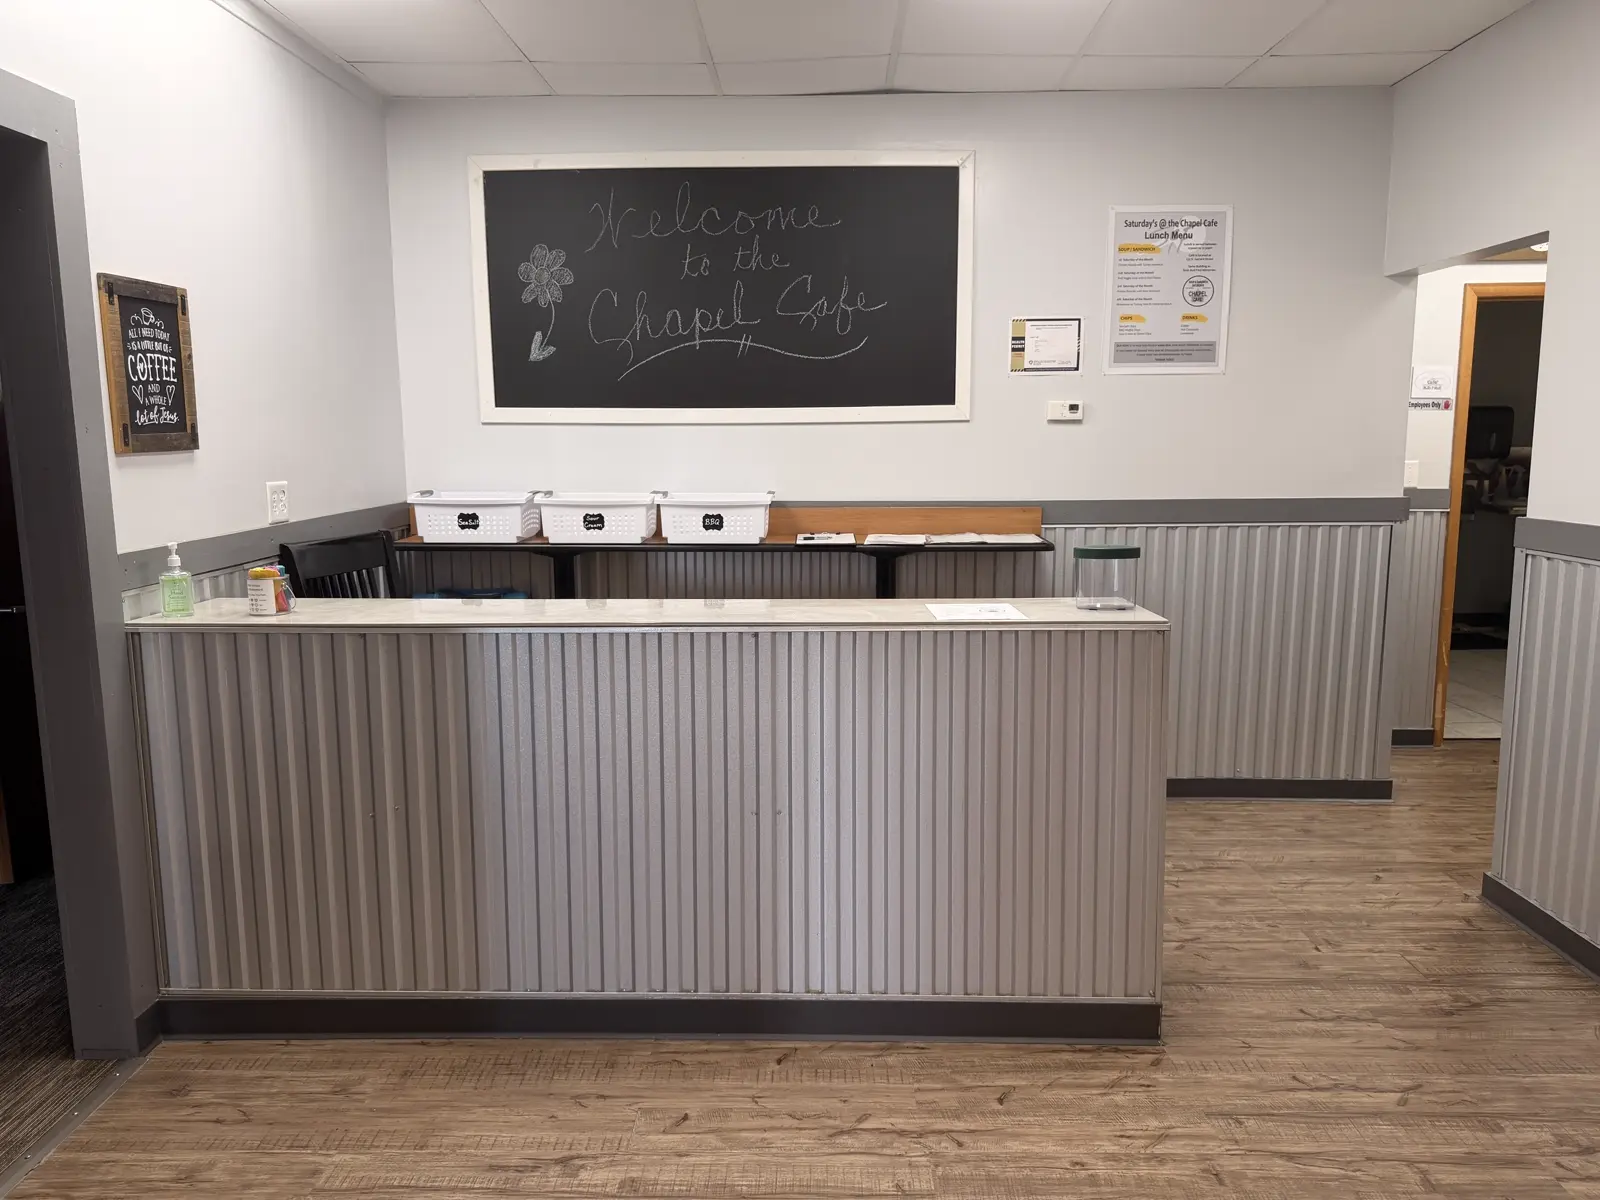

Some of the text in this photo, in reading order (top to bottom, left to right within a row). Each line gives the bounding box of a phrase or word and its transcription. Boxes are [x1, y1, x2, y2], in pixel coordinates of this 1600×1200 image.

[584, 181, 842, 253] Welcome
[1124, 218, 1218, 229] Saturday's @ the Chapel Cafe
[1144, 231, 1193, 240] Lunch Menu
[681, 235, 790, 279] to the
[588, 275, 887, 366] Chapel Cafe
[128, 328, 171, 342] ALL I NEED TODAY
[131, 341, 137, 350] IS
[137, 340, 141, 349] A
[141, 340, 154, 350] LITTLE
[127, 353, 178, 383] COFFEE
[147, 383, 161, 394] AND
[144, 395, 167, 406] A WHOLE
[1408, 401, 1441, 409] Employees Only
[135, 409, 149, 426] lot
[149, 405, 160, 424] of
[458, 518, 468, 526] Sea
[704, 518, 720, 526] BBQ
